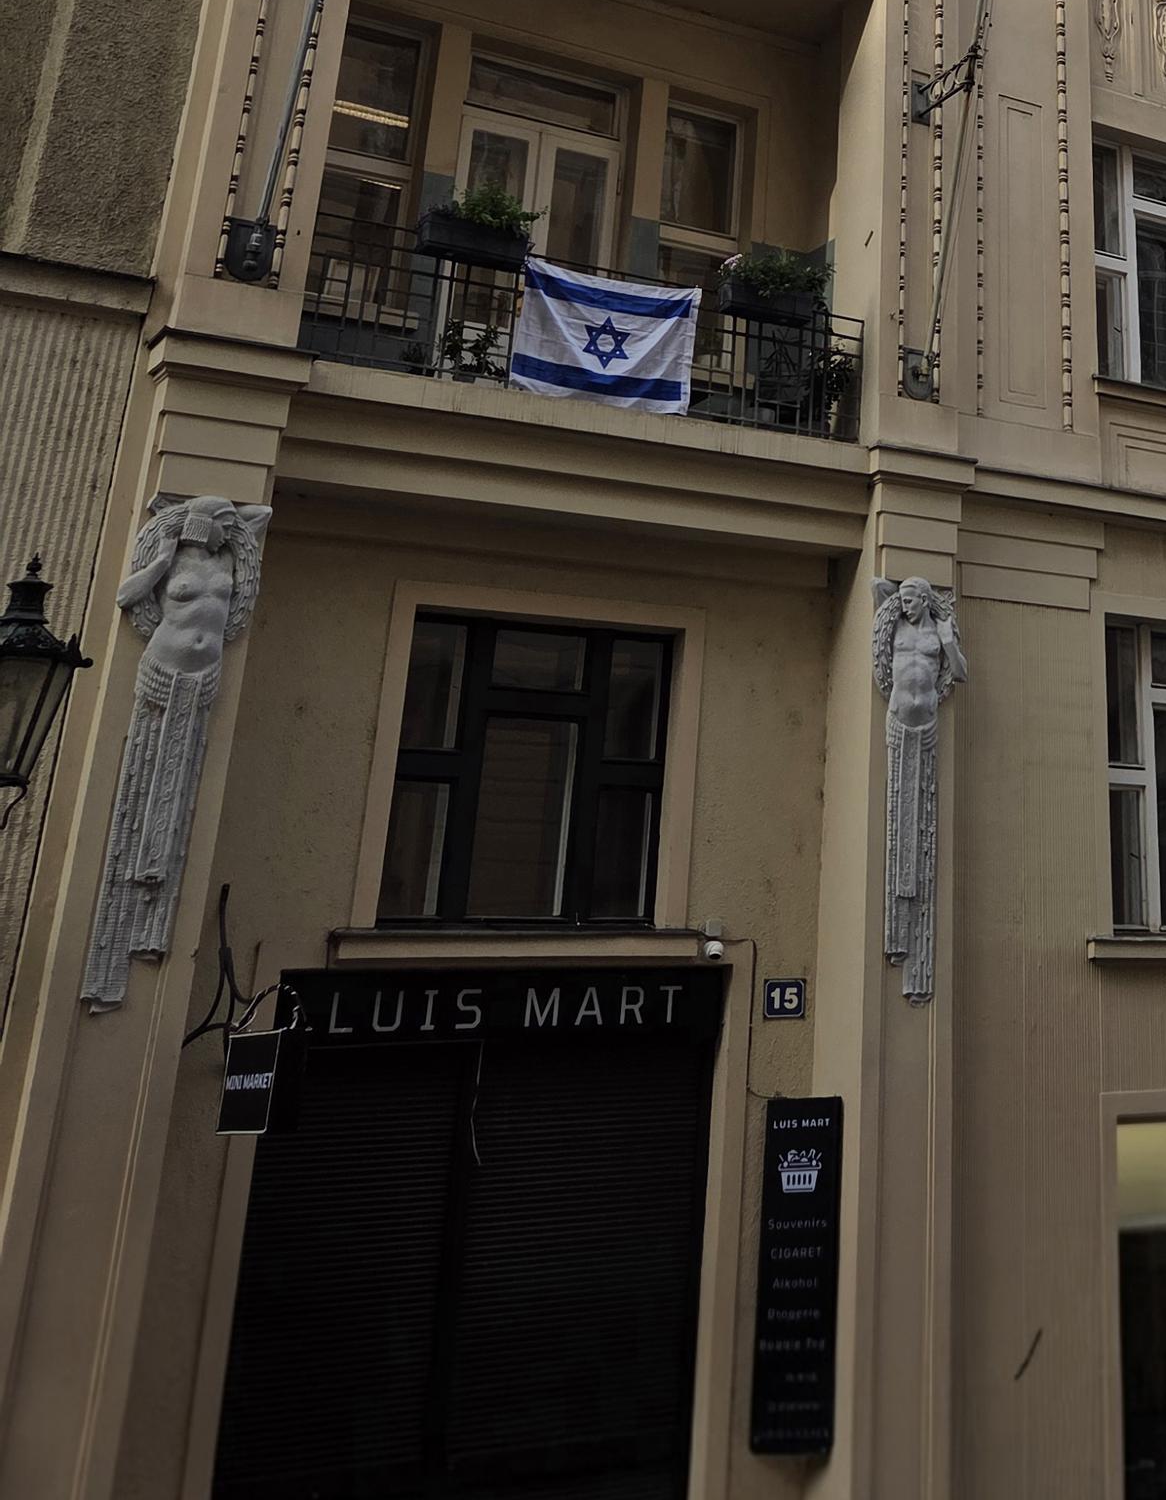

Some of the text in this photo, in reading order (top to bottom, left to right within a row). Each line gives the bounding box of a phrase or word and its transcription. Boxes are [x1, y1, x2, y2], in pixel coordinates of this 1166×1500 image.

[769, 986, 799, 1011] 15
[328, 984, 683, 1034] LUIS MART
[225, 1072, 273, 1090] MINI MARKET
[773, 1117, 831, 1130] LUIS MART
[767, 1217, 828, 1230] Souvenirs
[770, 1246, 822, 1260] CIGARET
